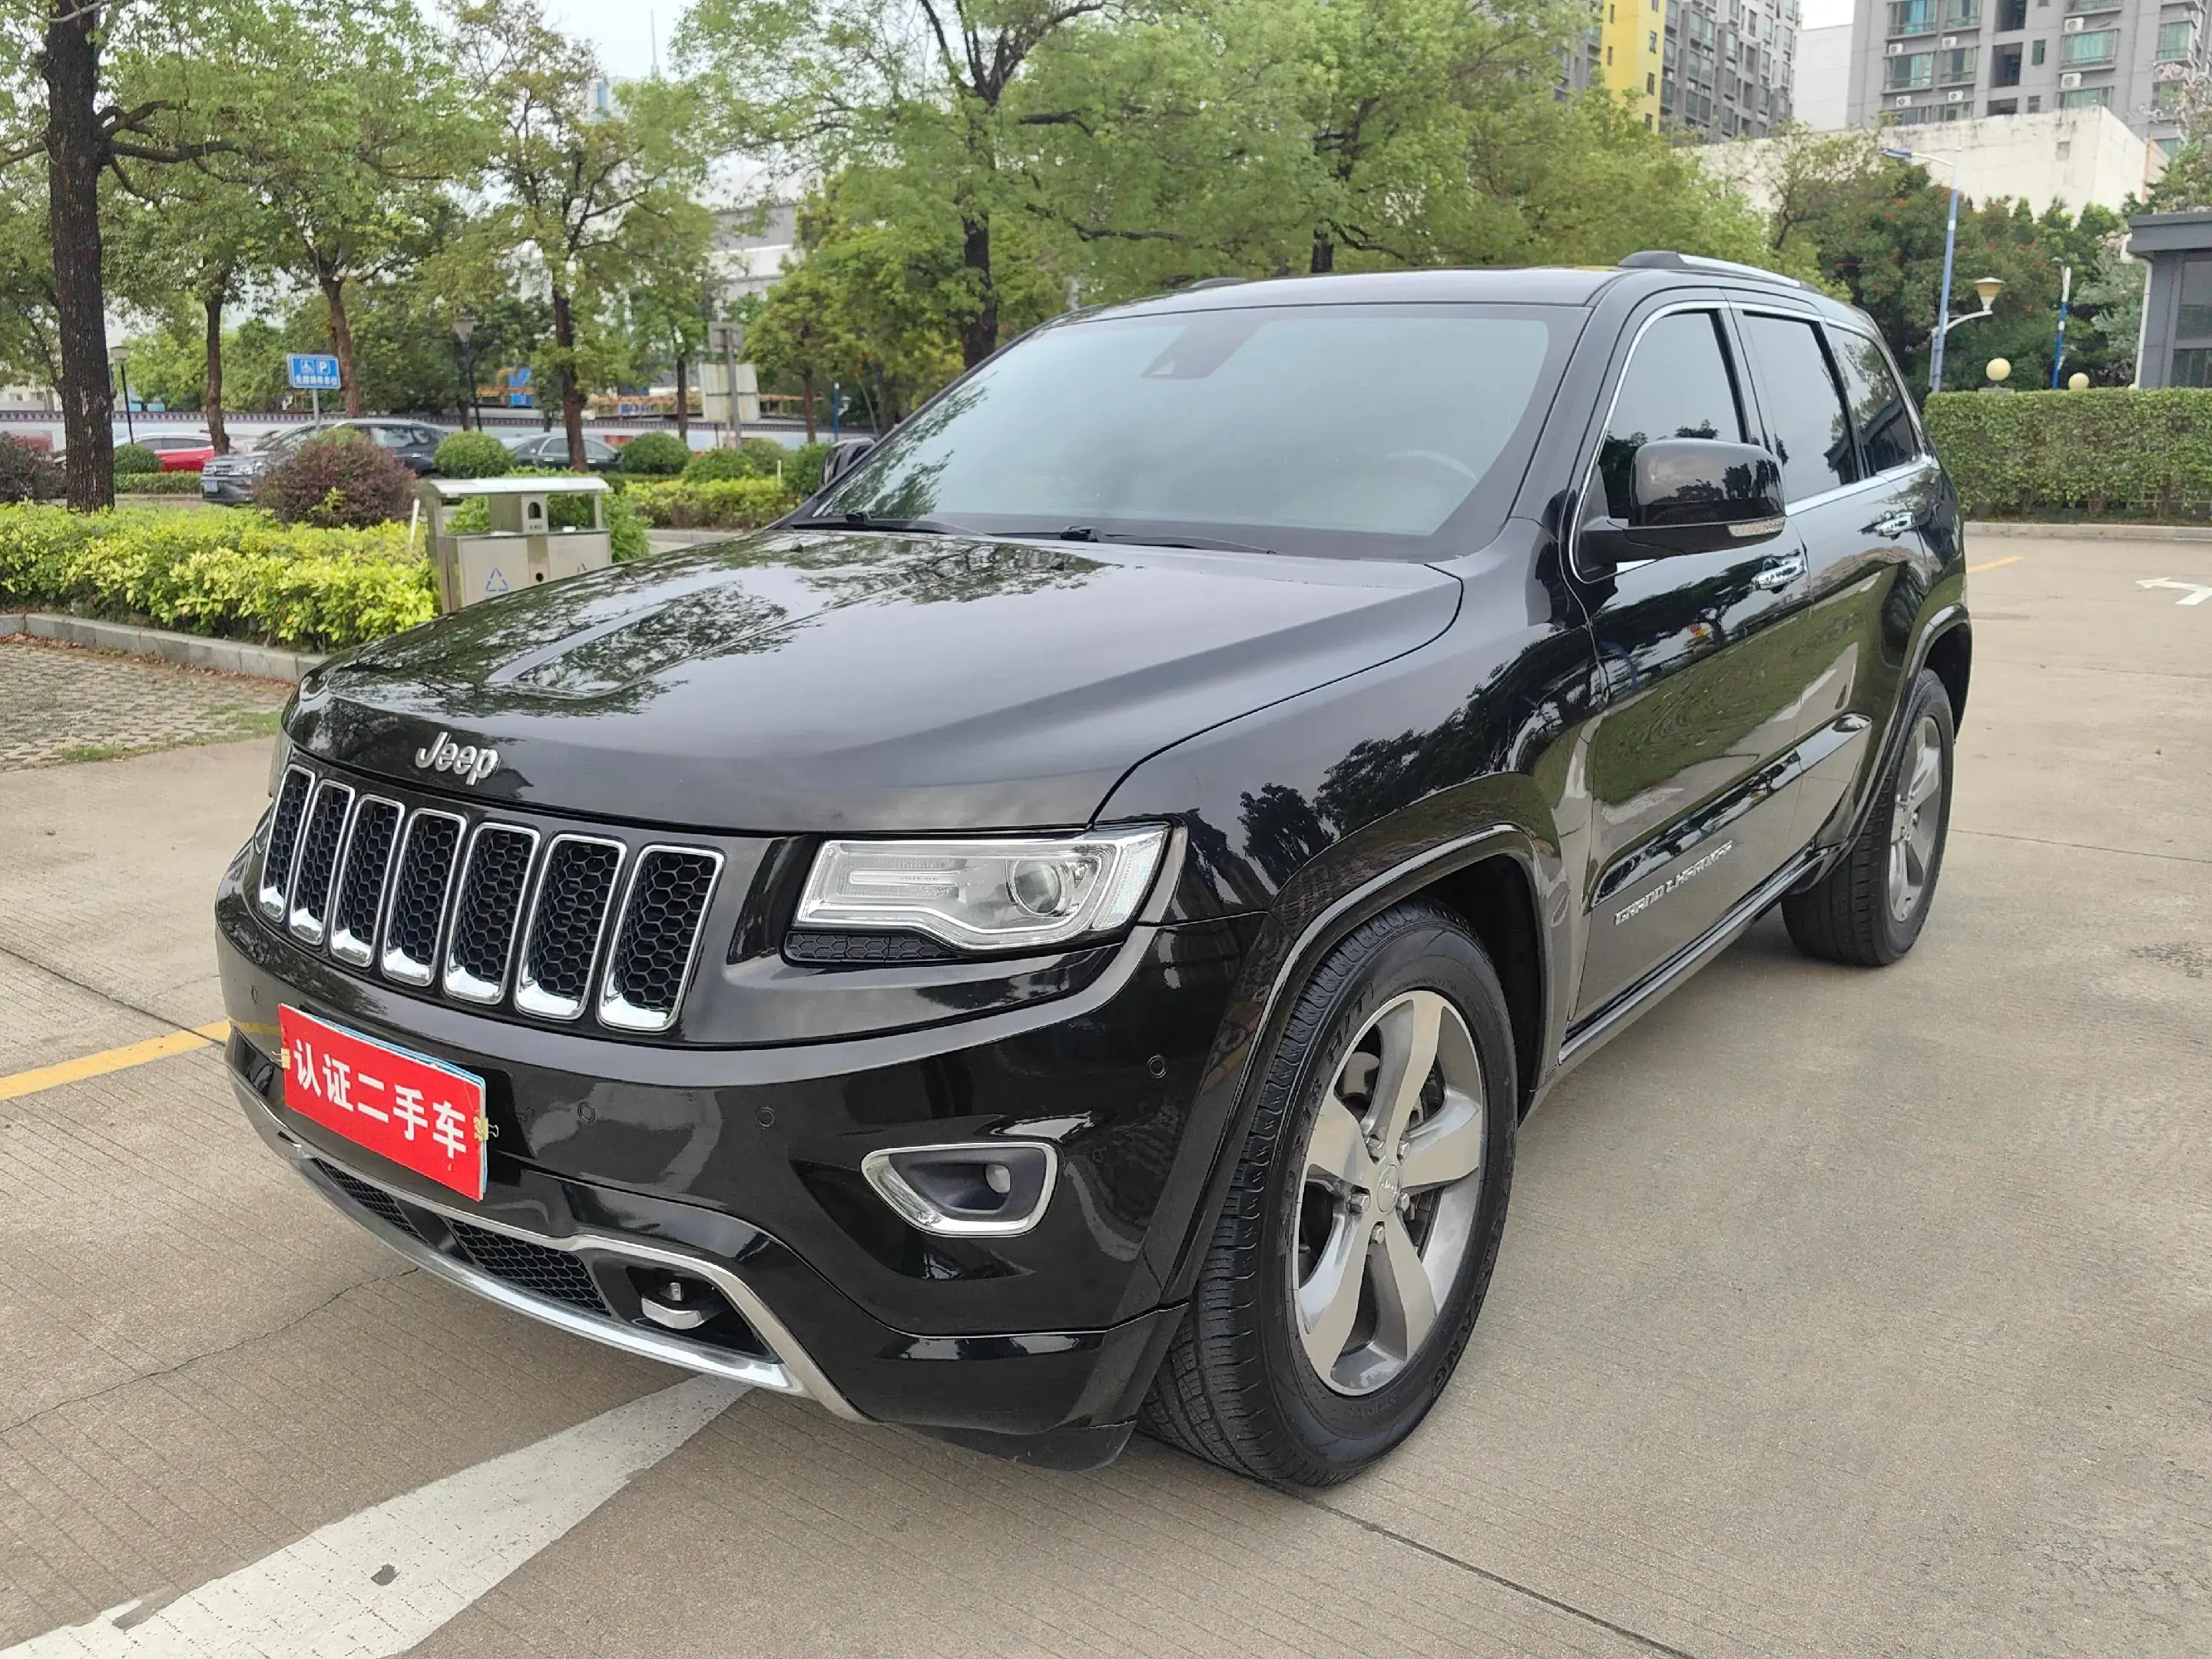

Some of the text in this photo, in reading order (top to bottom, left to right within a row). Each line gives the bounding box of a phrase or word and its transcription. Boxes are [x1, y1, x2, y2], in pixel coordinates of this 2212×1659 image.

[416, 731, 499, 786] Jeep
[293, 1039, 467, 1159] 认证二手车
